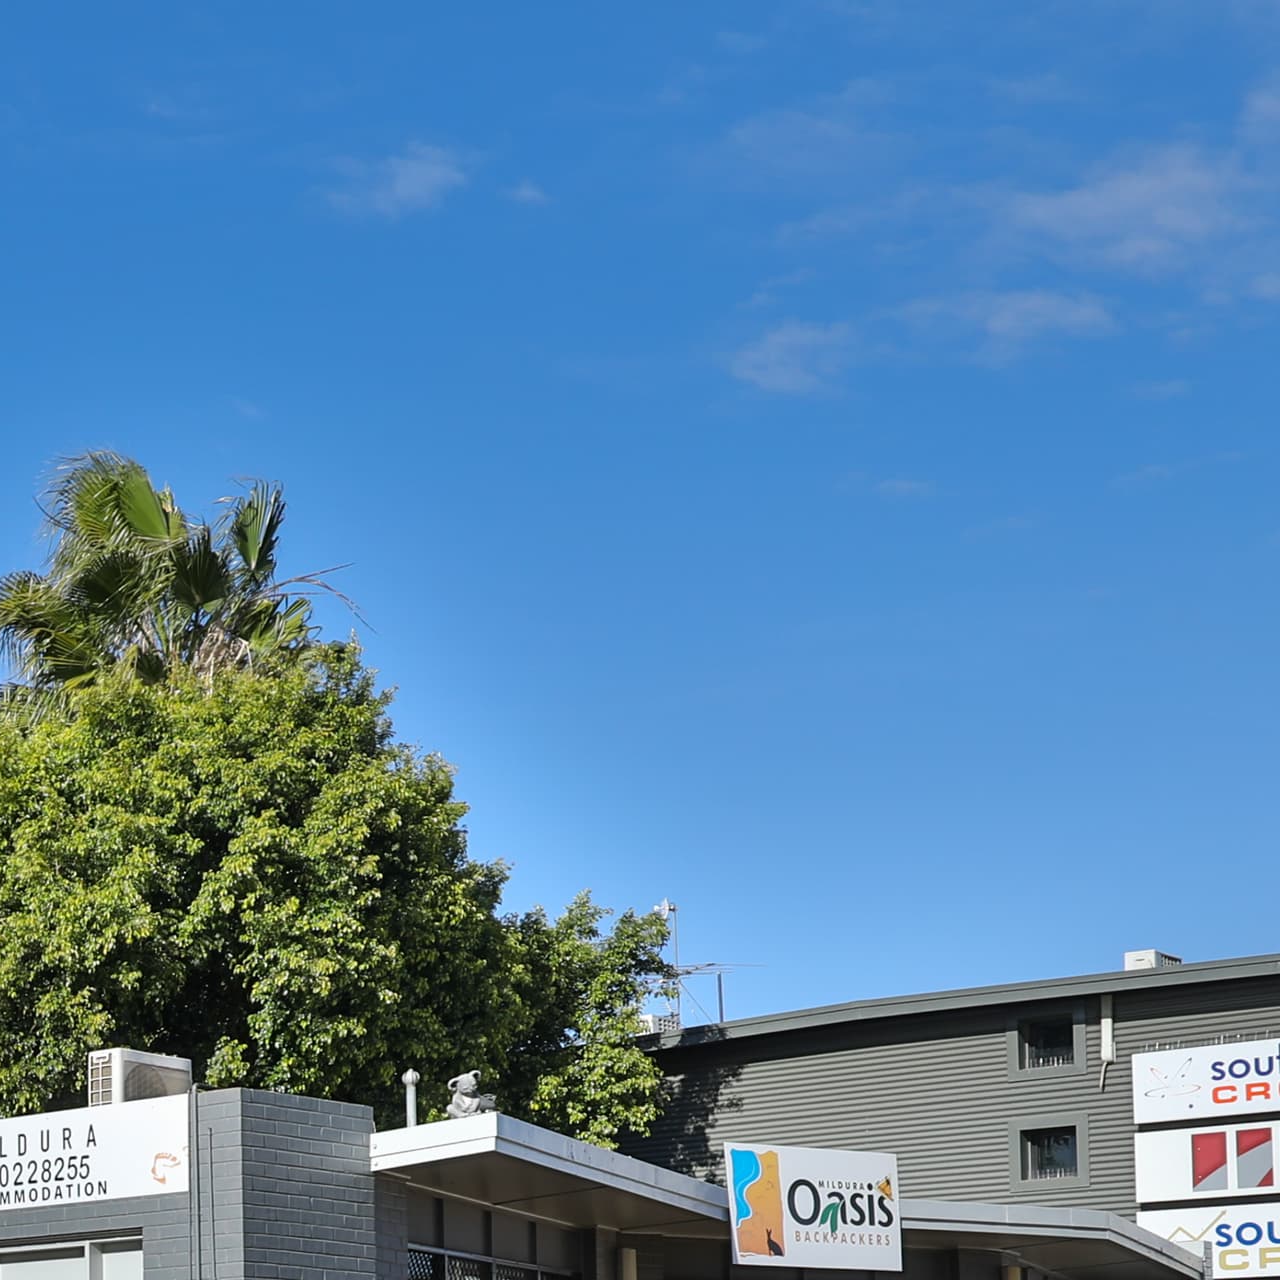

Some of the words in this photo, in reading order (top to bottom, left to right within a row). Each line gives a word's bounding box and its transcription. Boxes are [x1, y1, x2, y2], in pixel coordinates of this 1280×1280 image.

[1212, 1082, 1280, 1104] CR
[818, 1179, 865, 1190] MILDURA
[787, 1179, 894, 1231] Oasis
[795, 1230, 891, 1246] BACKPACKERS
